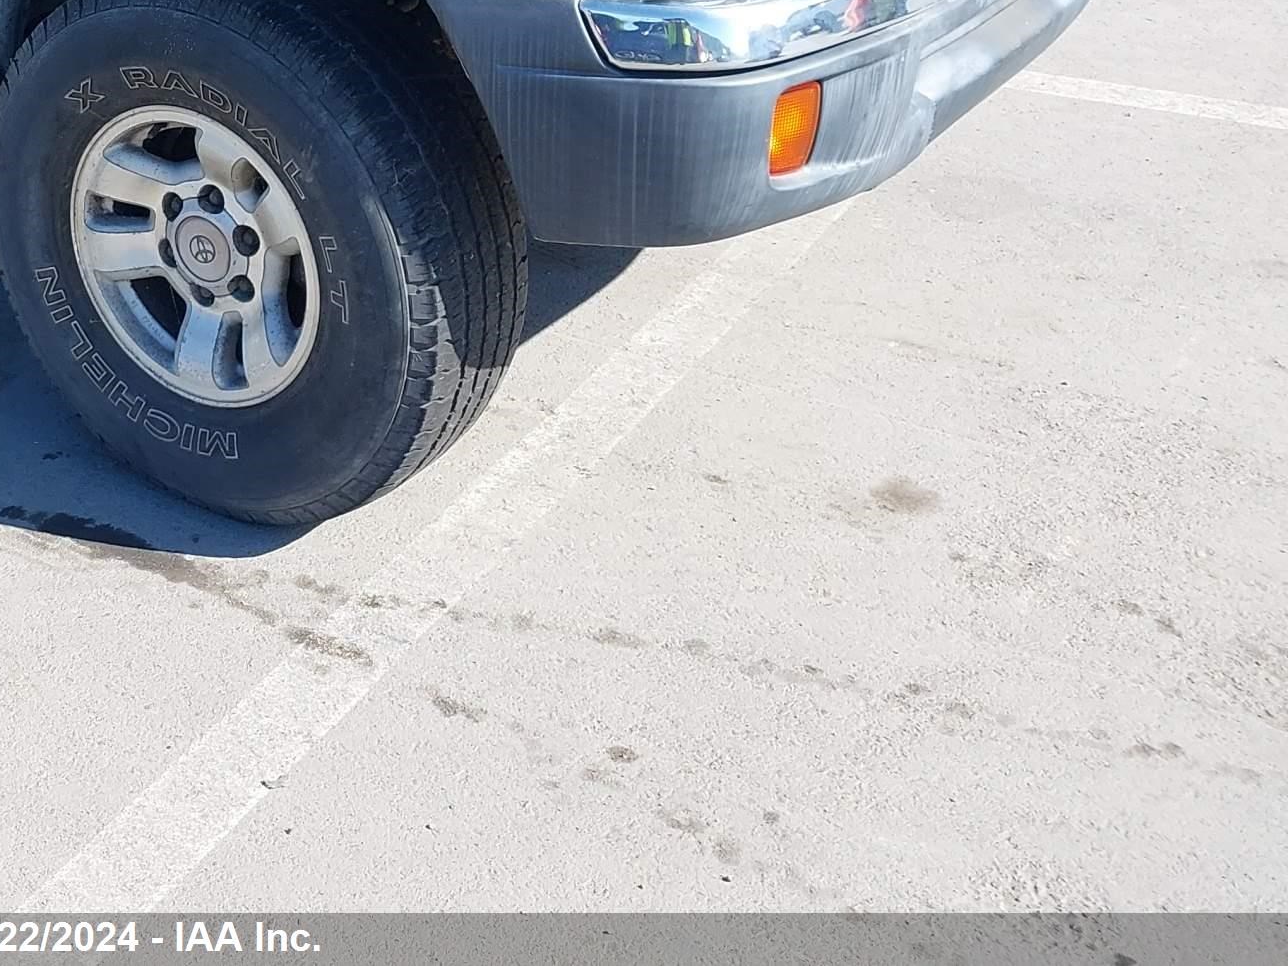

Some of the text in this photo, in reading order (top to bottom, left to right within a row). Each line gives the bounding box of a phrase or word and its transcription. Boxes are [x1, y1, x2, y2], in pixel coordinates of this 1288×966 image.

[64, 77, 106, 114] X
[119, 65, 306, 201] RADIAL
[34, 266, 239, 460] MICHELIN
